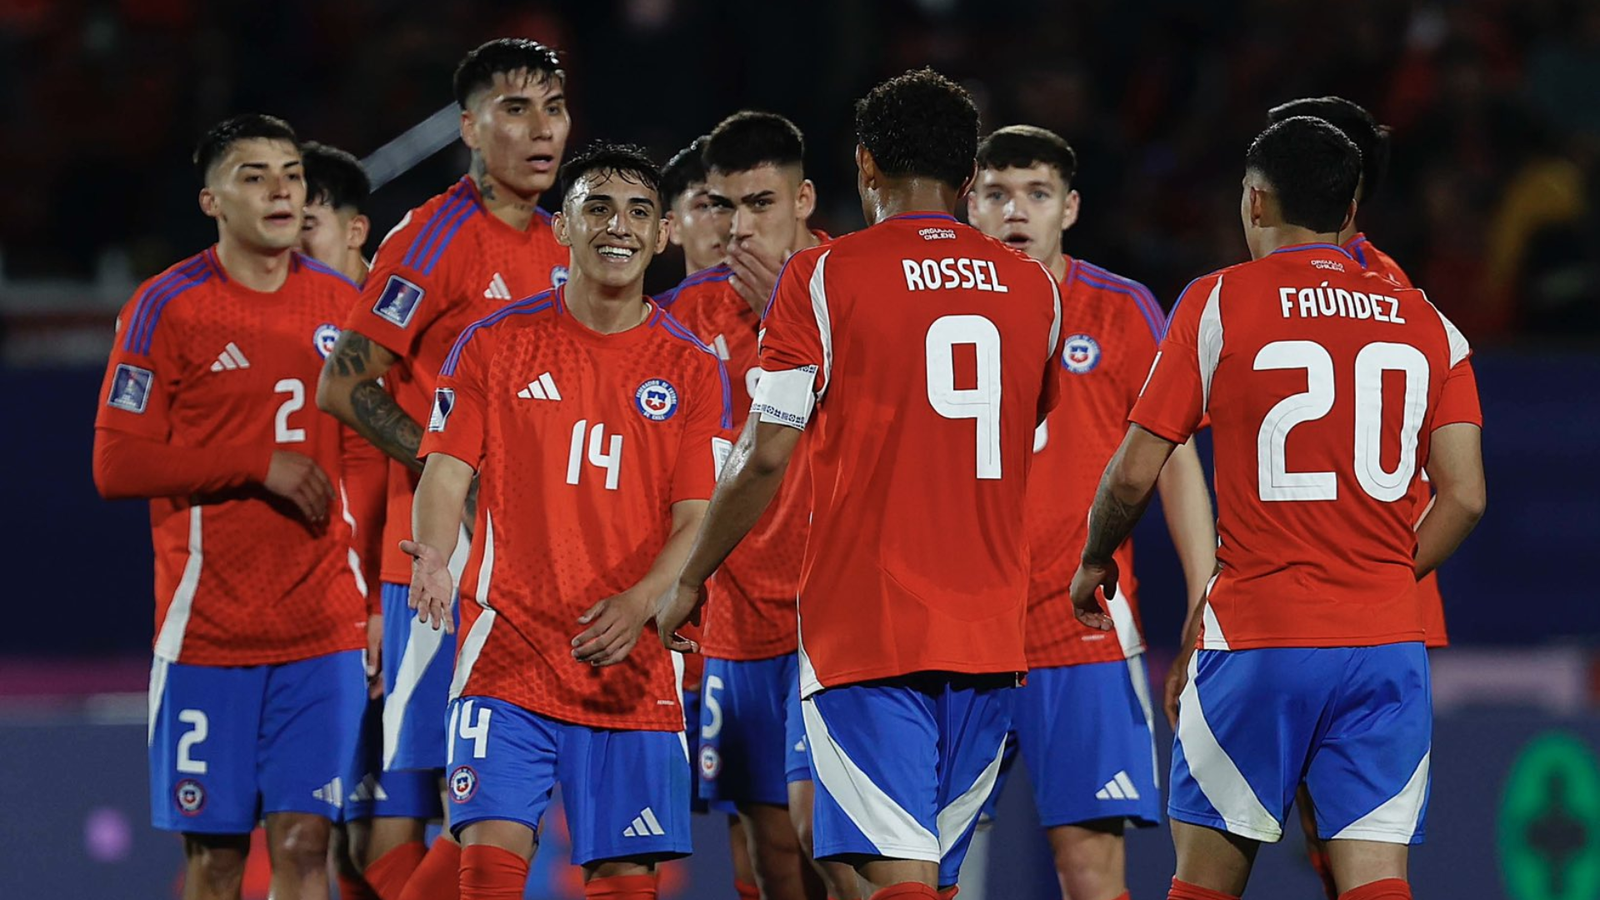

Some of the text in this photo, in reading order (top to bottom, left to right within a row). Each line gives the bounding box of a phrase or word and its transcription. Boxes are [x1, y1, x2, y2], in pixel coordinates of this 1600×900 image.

[902, 257, 1009, 294] ROSSEL
[1279, 281, 1406, 325] FAÚNDEZ
[274, 378, 306, 443] 2
[925, 314, 1002, 480] 9
[1253, 340, 1431, 503] 20
[566, 419, 623, 490] 14
[447, 700, 492, 766] 14
[702, 674, 724, 739] 5
[176, 709, 208, 774] 2
